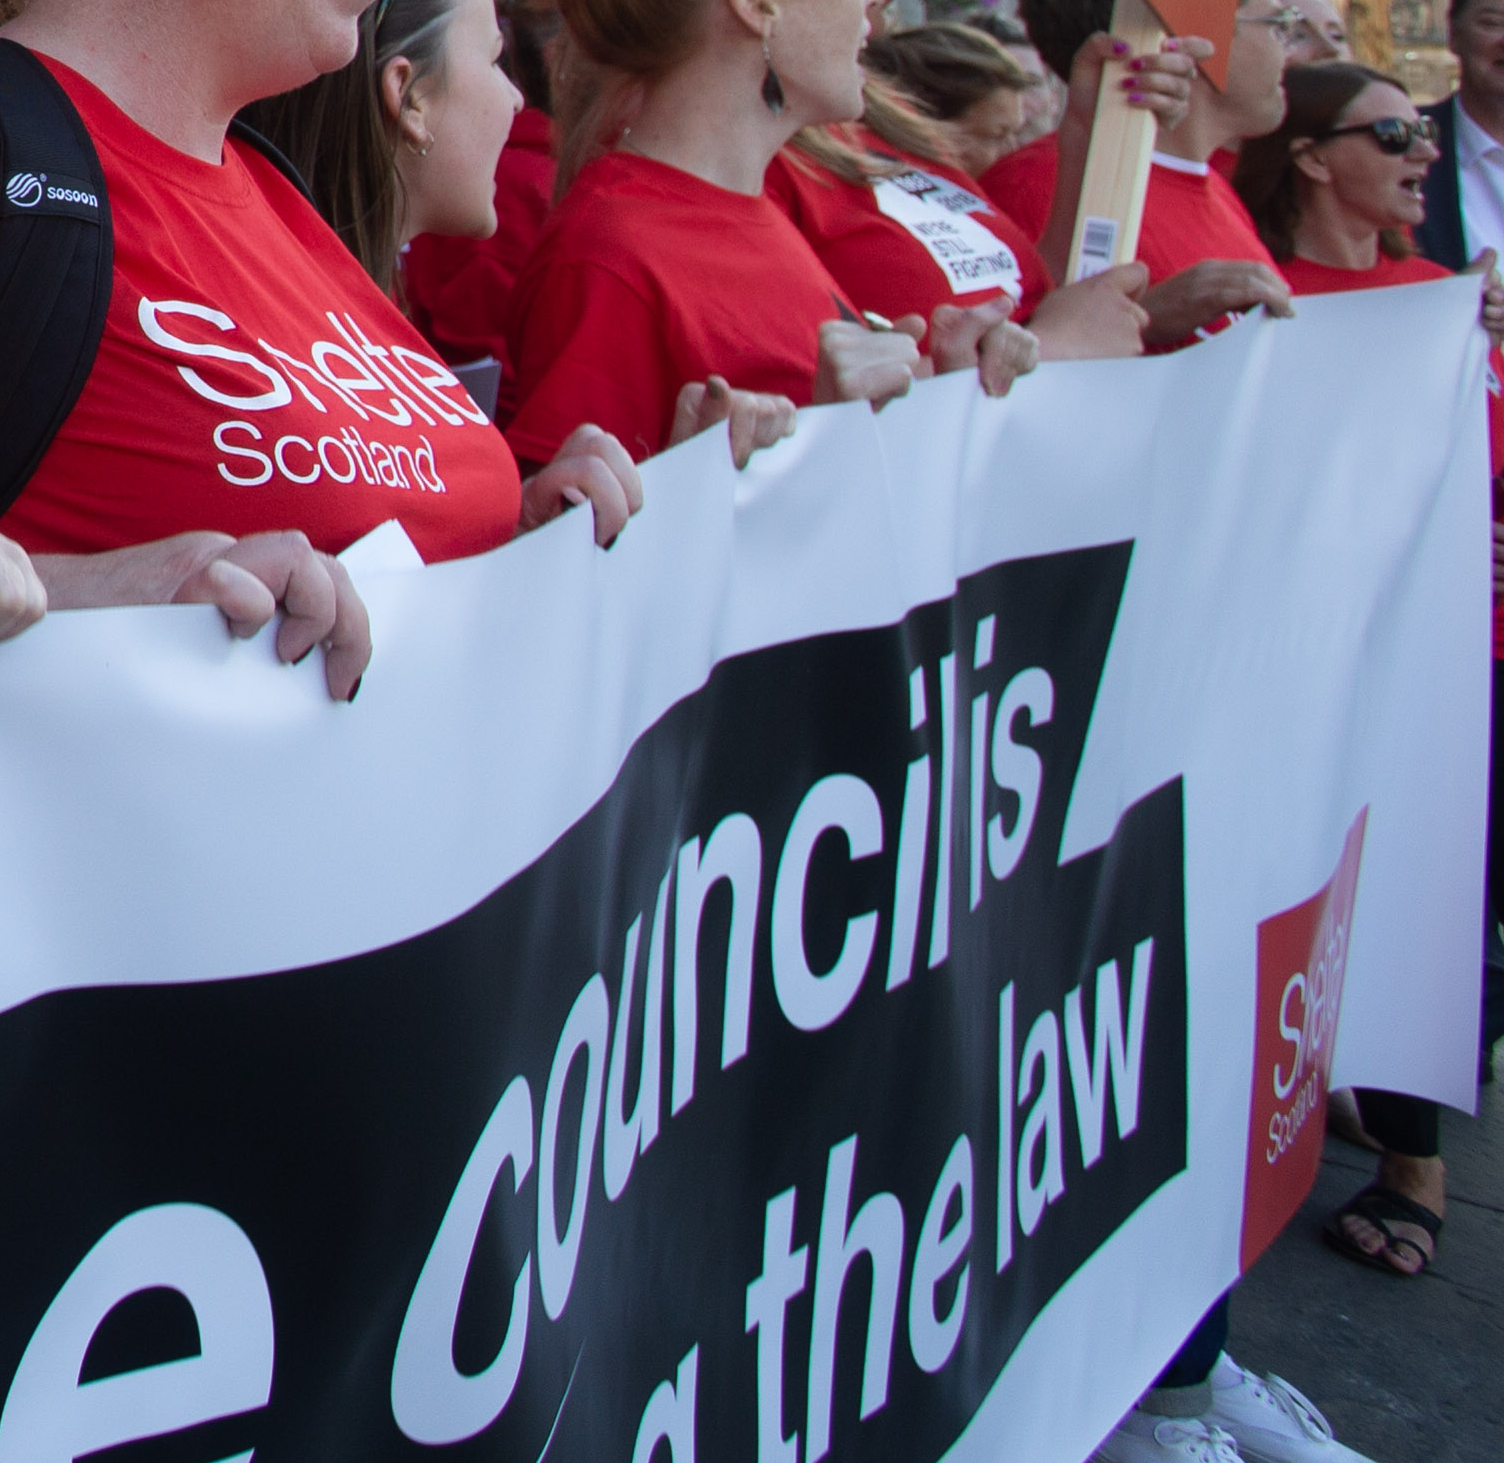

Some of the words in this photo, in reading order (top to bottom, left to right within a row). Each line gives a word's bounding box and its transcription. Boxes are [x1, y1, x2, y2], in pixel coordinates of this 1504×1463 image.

[47, 186, 98, 208] sosoon
[137, 296, 490, 427] Shelte
[213, 419, 446, 494] Scotland
[391, 649, 957, 1444] council
[970, 614, 1055, 912] is
[746, 1133, 973, 1463] the
[996, 935, 1153, 1274] law
